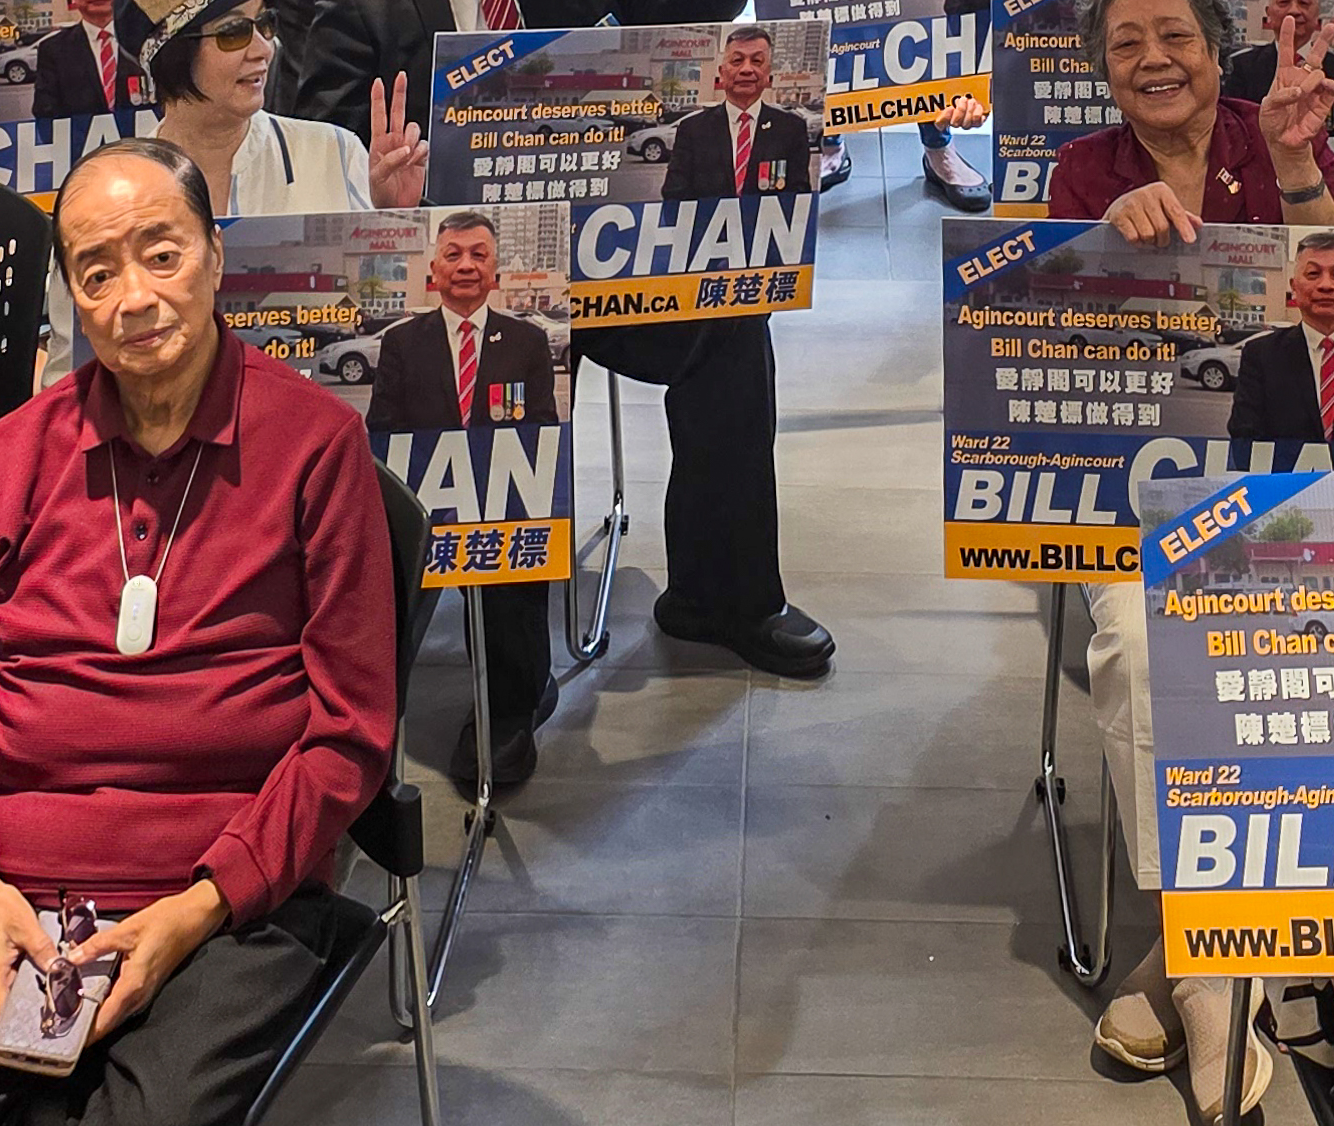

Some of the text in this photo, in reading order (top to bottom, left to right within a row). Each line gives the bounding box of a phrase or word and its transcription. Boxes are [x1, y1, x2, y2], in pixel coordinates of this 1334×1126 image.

[1005, 32, 1081, 51] Agincourt
[446, 38, 516, 91] ELECT
[445, 98, 663, 126] Agincourt deserves better,
[470, 125, 625, 150] Bill Chan can do it!
[577, 193, 812, 279] CHAN
[956, 229, 1037, 286] ELECT
[695, 269, 800, 309] 陳楚標
[296, 302, 362, 329] better,
[959, 305, 1221, 335] Agincourt deserves better,
[991, 337, 1177, 363] Bill Chan can do it!
[952, 434, 1010, 450] Ward 22
[951, 449, 1125, 471] Scarborough-Agincourt
[953, 470, 1117, 524] BILL
[1158, 486, 1253, 564] ELECT
[960, 542, 1141, 572] www.BILLC
[1164, 586, 1284, 619] Agincourt
[1206, 629, 1246, 657] Bill
[1251, 627, 1319, 656] Chan
[1166, 764, 1241, 786] Ward 22
